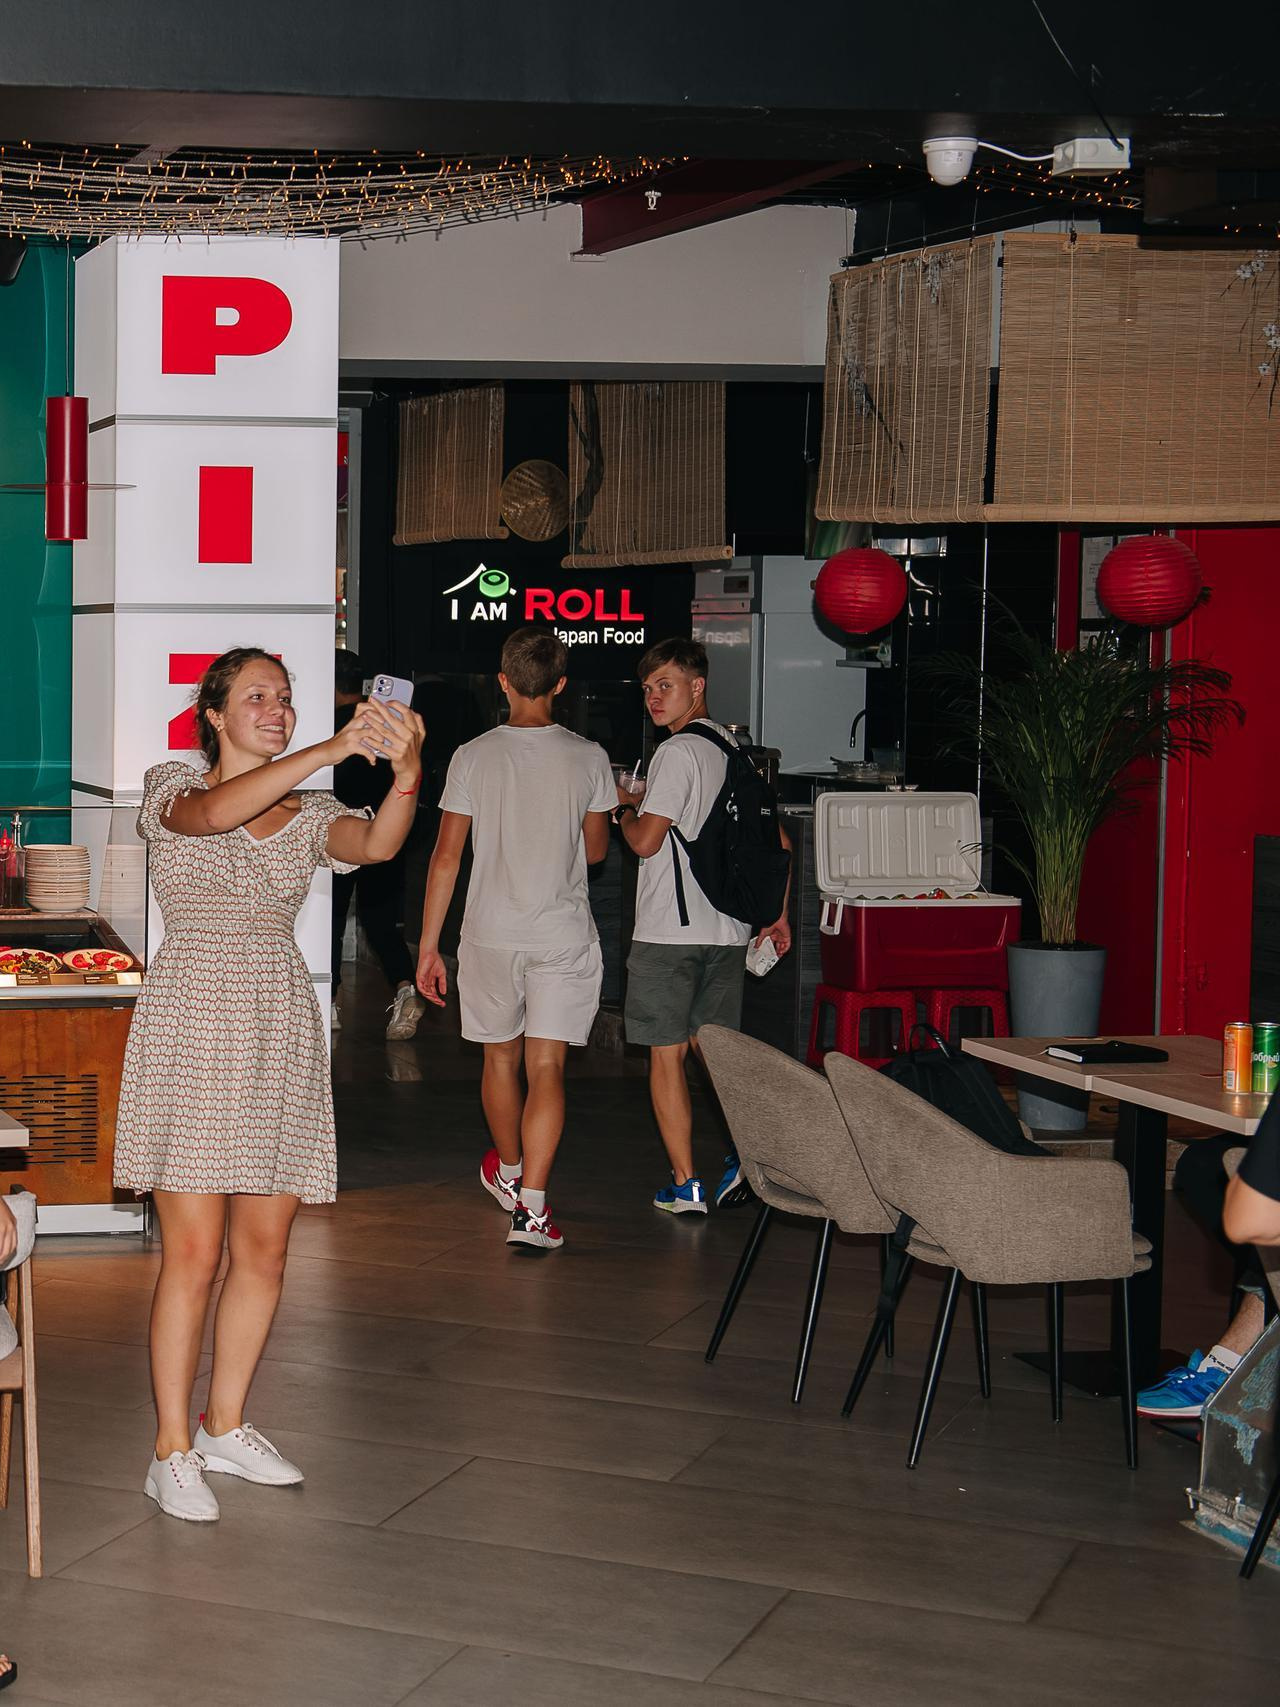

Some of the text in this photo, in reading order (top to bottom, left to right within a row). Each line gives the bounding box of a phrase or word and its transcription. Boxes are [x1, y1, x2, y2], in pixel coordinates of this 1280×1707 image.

[450, 588, 644, 622] I AM ROLL
[604, 628, 644, 644] Food
